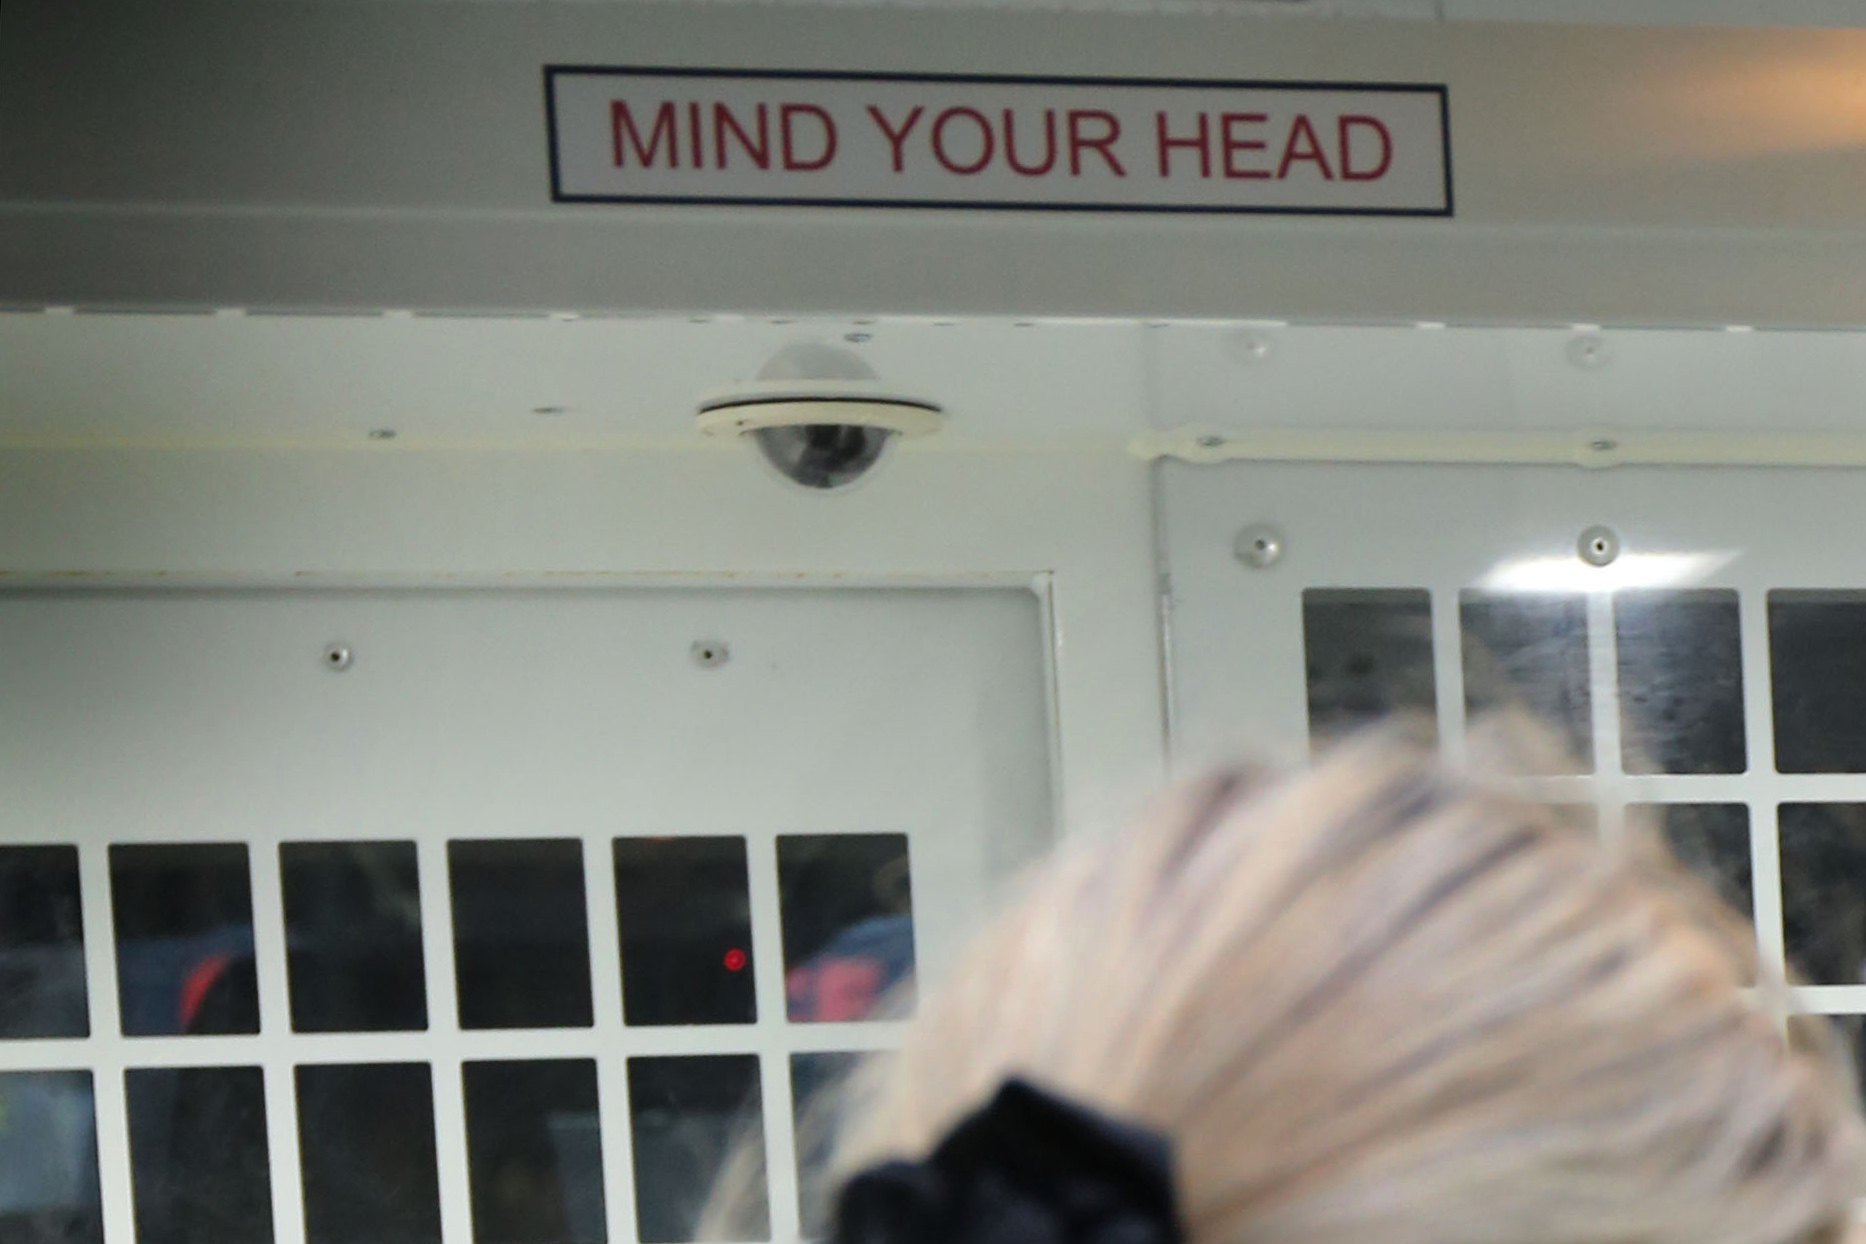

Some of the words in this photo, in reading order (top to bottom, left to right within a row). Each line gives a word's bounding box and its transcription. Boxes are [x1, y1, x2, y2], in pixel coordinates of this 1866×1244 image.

[609, 99, 839, 173] MIND
[867, 103, 1127, 179] YOUR
[1156, 110, 1394, 184] HEAD
